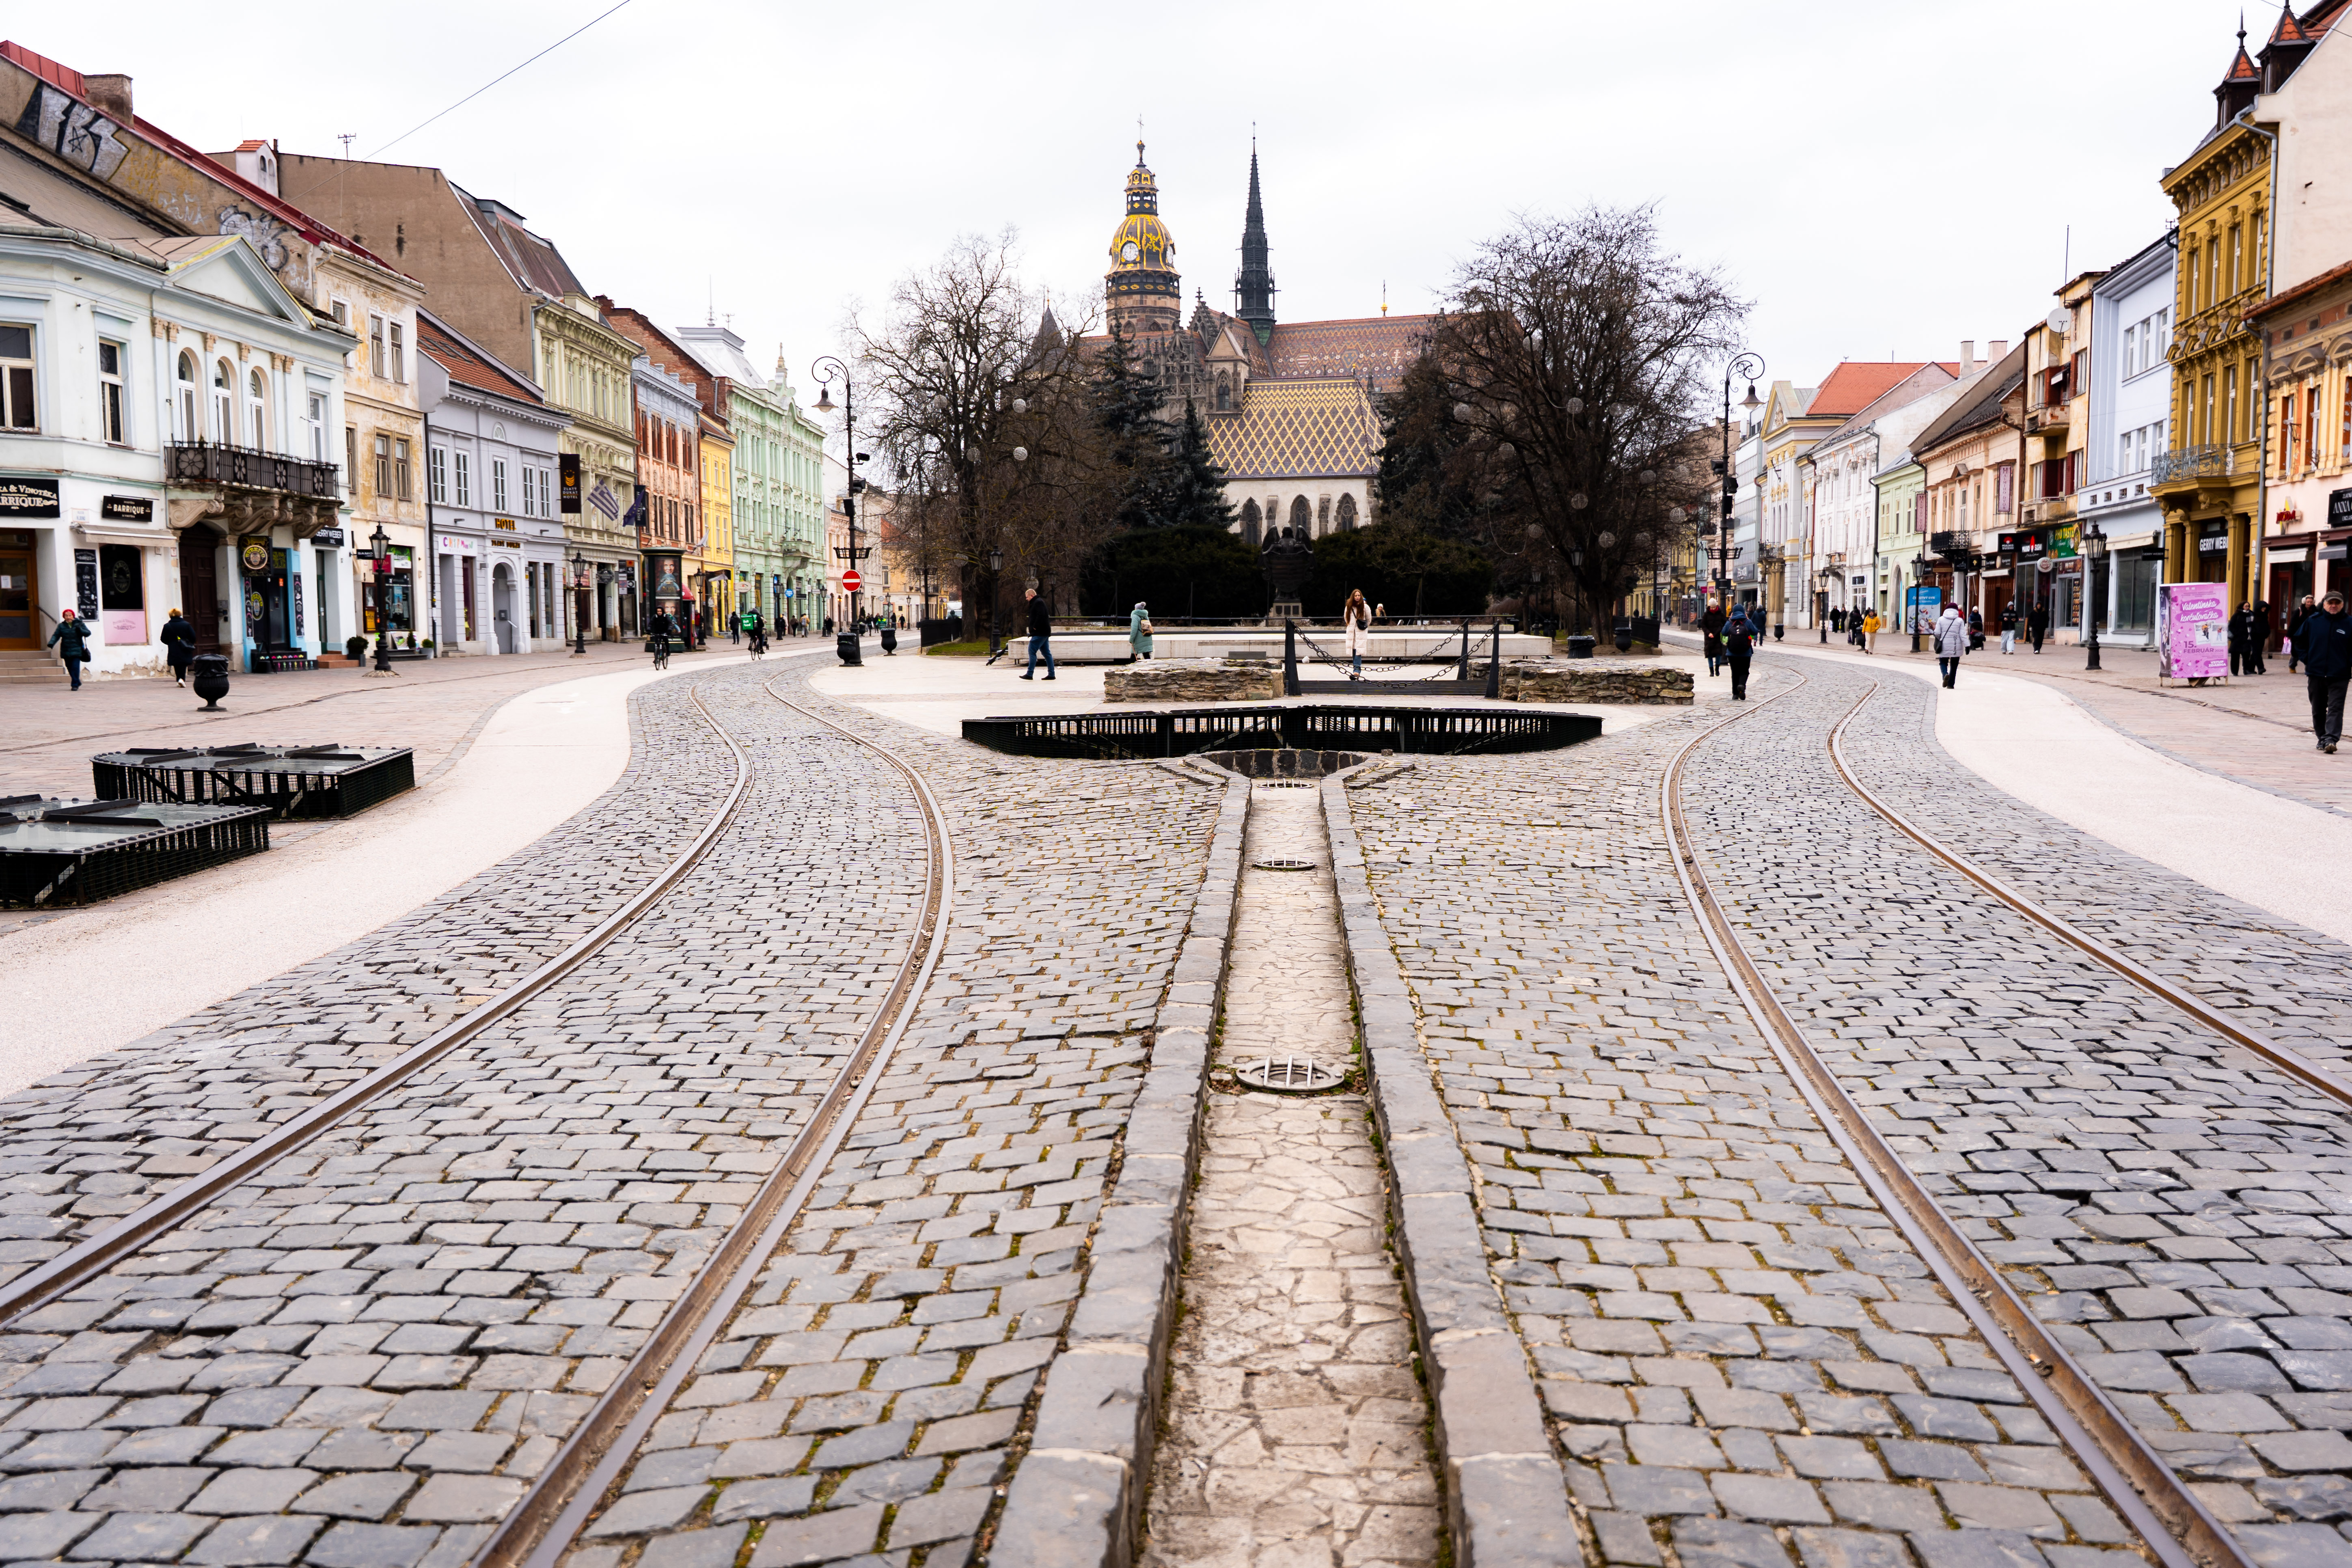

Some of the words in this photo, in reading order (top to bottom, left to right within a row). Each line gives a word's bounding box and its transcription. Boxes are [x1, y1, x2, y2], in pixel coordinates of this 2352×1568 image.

[0, 496, 44, 507] RRIQUE
[113, 504, 145, 515] BARRIQUE
[494, 518, 517, 531] HOTEL
[328, 530, 342, 539] WEBER
[2199, 538, 2213, 552] GERRY
[2182, 599, 2217, 611] Valentínska
[2180, 610, 2218, 622] korčuľovačka
